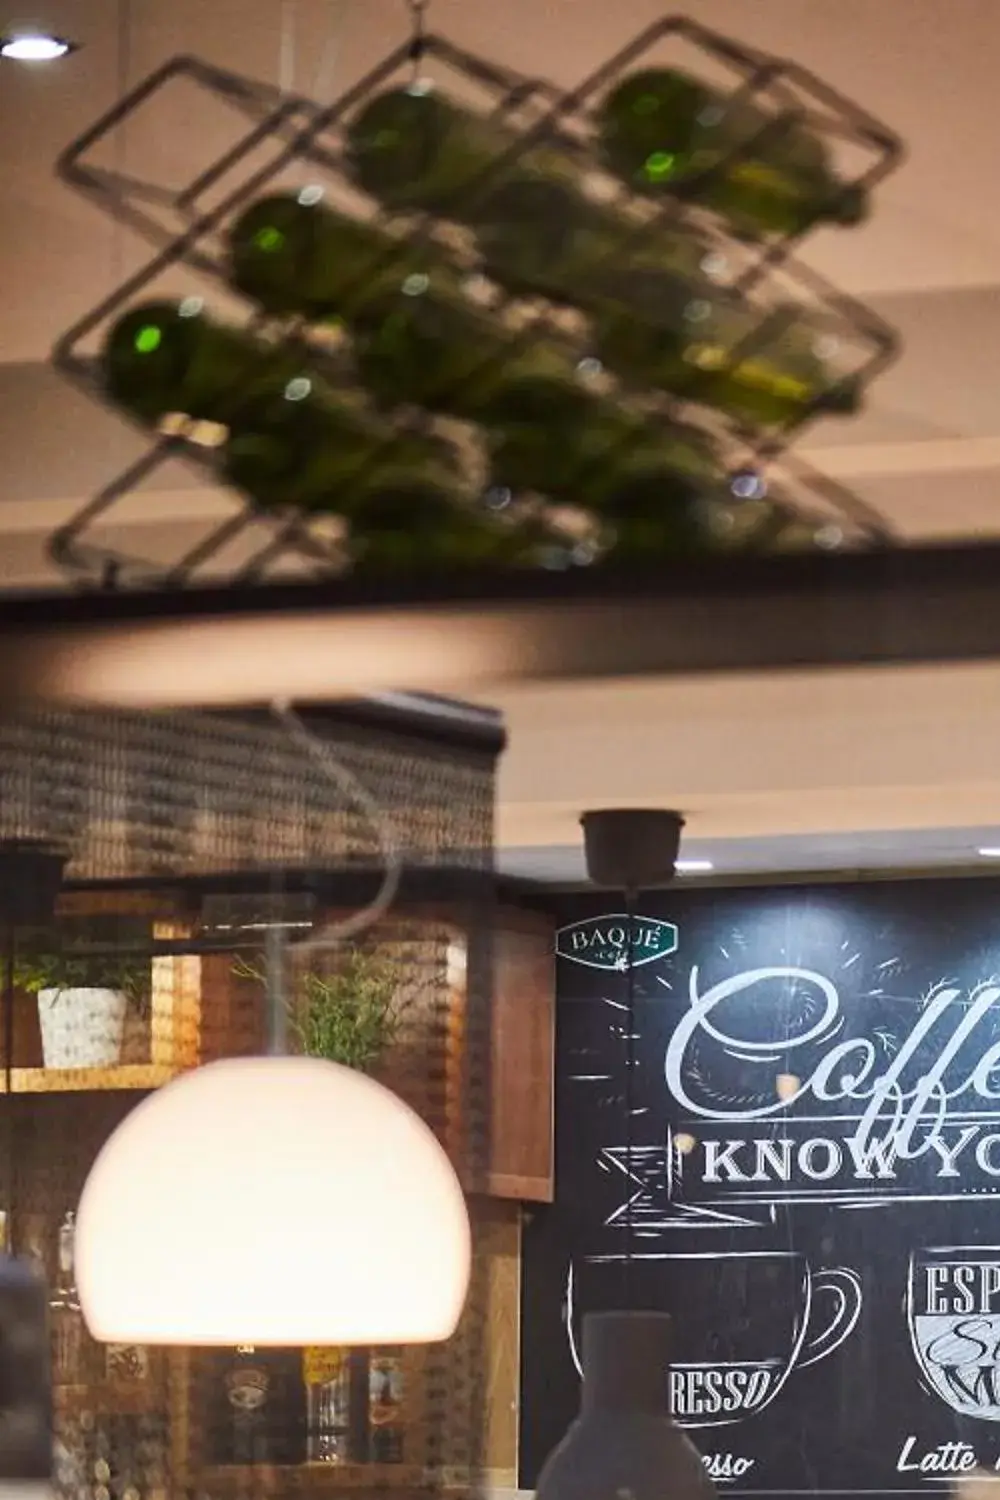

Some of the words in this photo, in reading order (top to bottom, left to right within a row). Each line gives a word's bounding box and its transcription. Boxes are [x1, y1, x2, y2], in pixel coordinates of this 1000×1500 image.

[571, 925, 661, 950] BAQUÉ
[703, 1137, 897, 1183] KNOW
[669, 1371, 770, 1414] RESSO
[701, 1453, 755, 1477] esso
[896, 1435, 977, 1472] Latte
